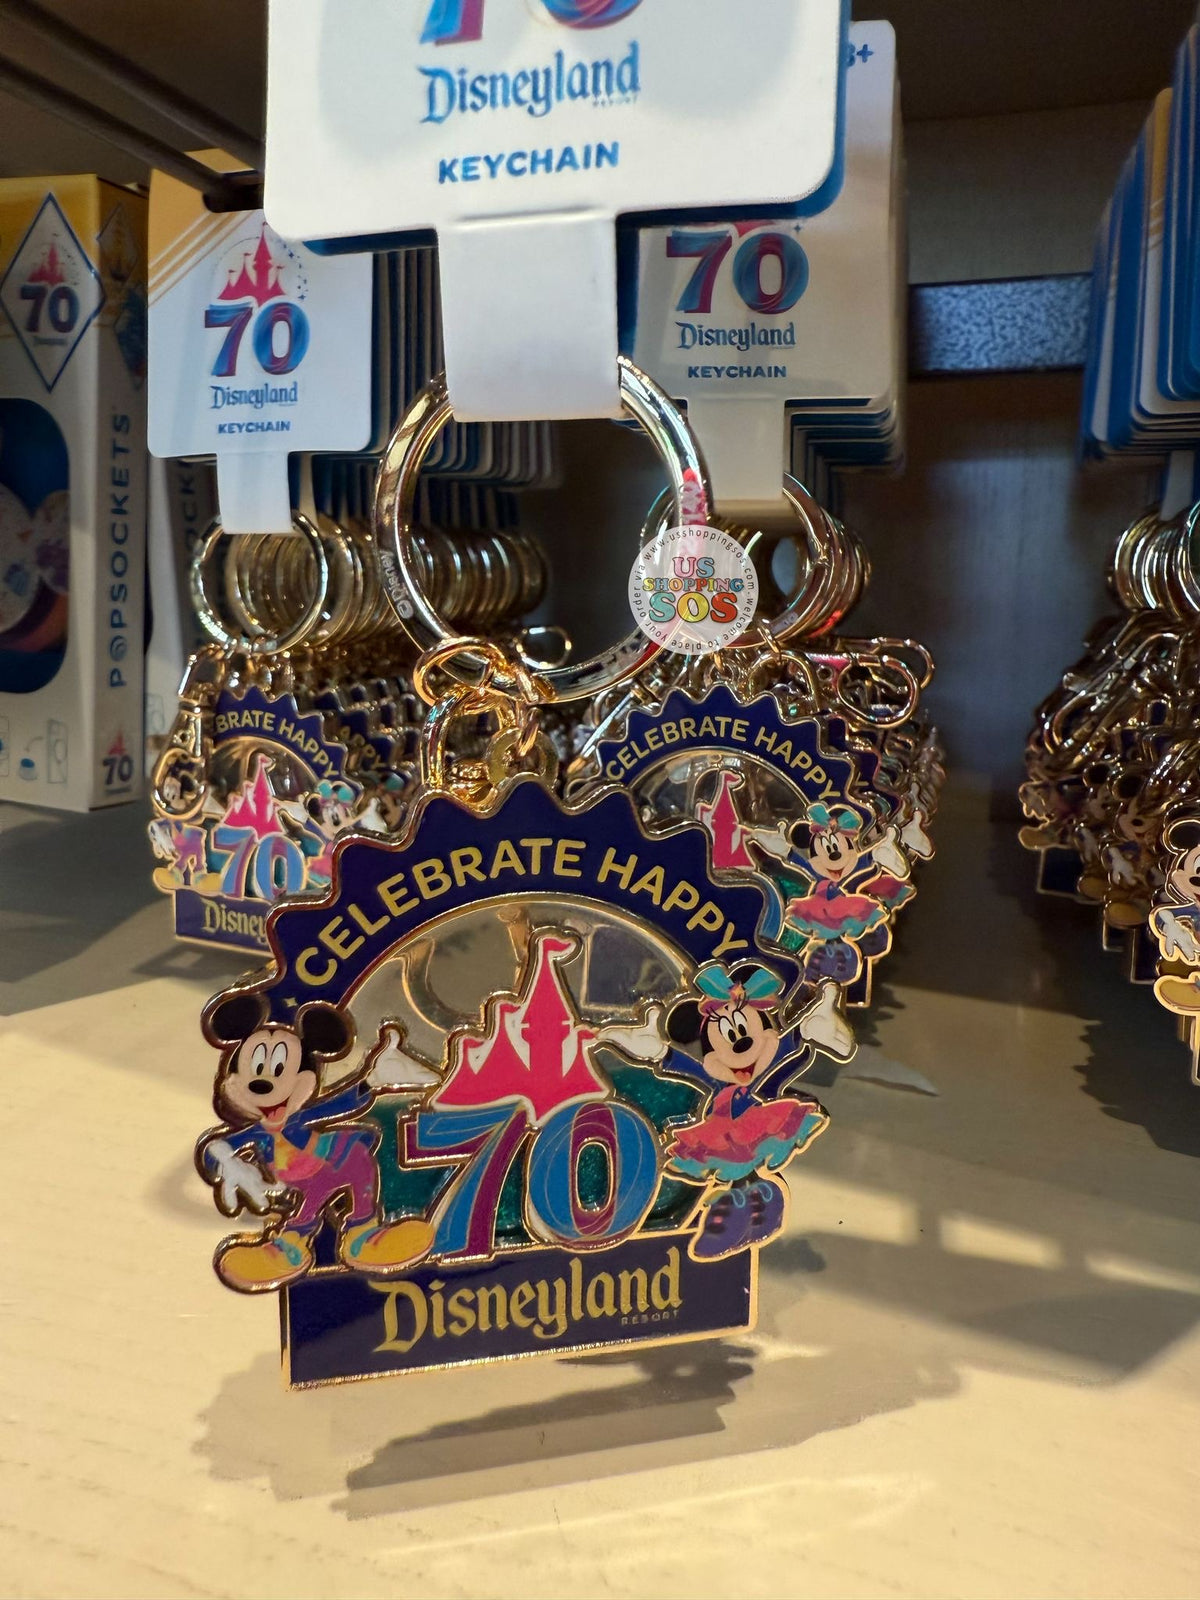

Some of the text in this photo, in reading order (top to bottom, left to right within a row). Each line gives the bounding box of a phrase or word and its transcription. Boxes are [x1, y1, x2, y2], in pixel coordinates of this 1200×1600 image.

[416, 40, 641, 124] Disneyland
[438, 141, 619, 184] KEYCHAIN
[666, 230, 809, 315] 70
[20, 284, 80, 333] 70
[205, 302, 310, 377] 70
[675, 321, 796, 351] Disneyland
[210, 381, 298, 410] Disneyland
[688, 365, 787, 378] KEYCHAIN
[218, 420, 291, 434] KEYCHAIN
[103, 754, 134, 786] 70
[279, 717, 339, 778] HAPPY
[605, 716, 842, 801] CELEBRATE HAPPY
[210, 826, 306, 901] 70
[295, 837, 750, 987] CELEBRATE HAPPY
[400, 1099, 660, 1266] 70
[367, 1245, 683, 1354] Disneyland
